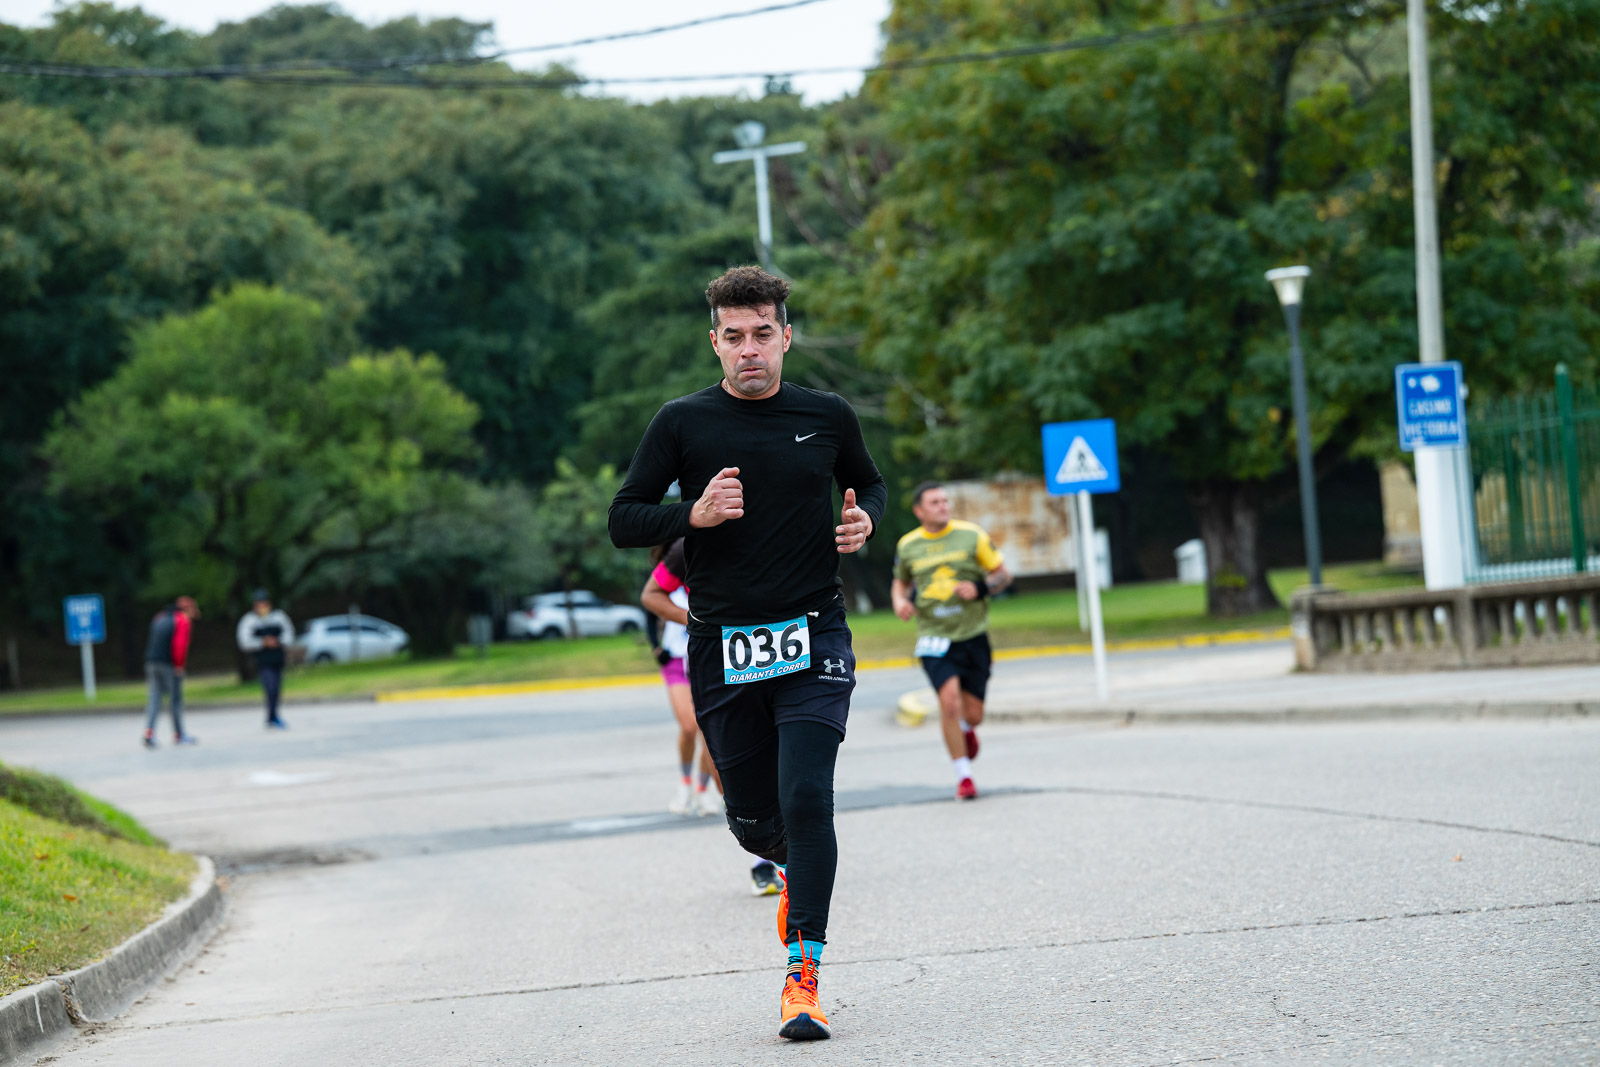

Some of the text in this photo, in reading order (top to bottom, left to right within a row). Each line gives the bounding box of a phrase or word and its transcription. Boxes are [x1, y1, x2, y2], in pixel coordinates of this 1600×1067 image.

[728, 622, 803, 671] 036
[729, 661, 807, 683] DIAMANTE CORRE
